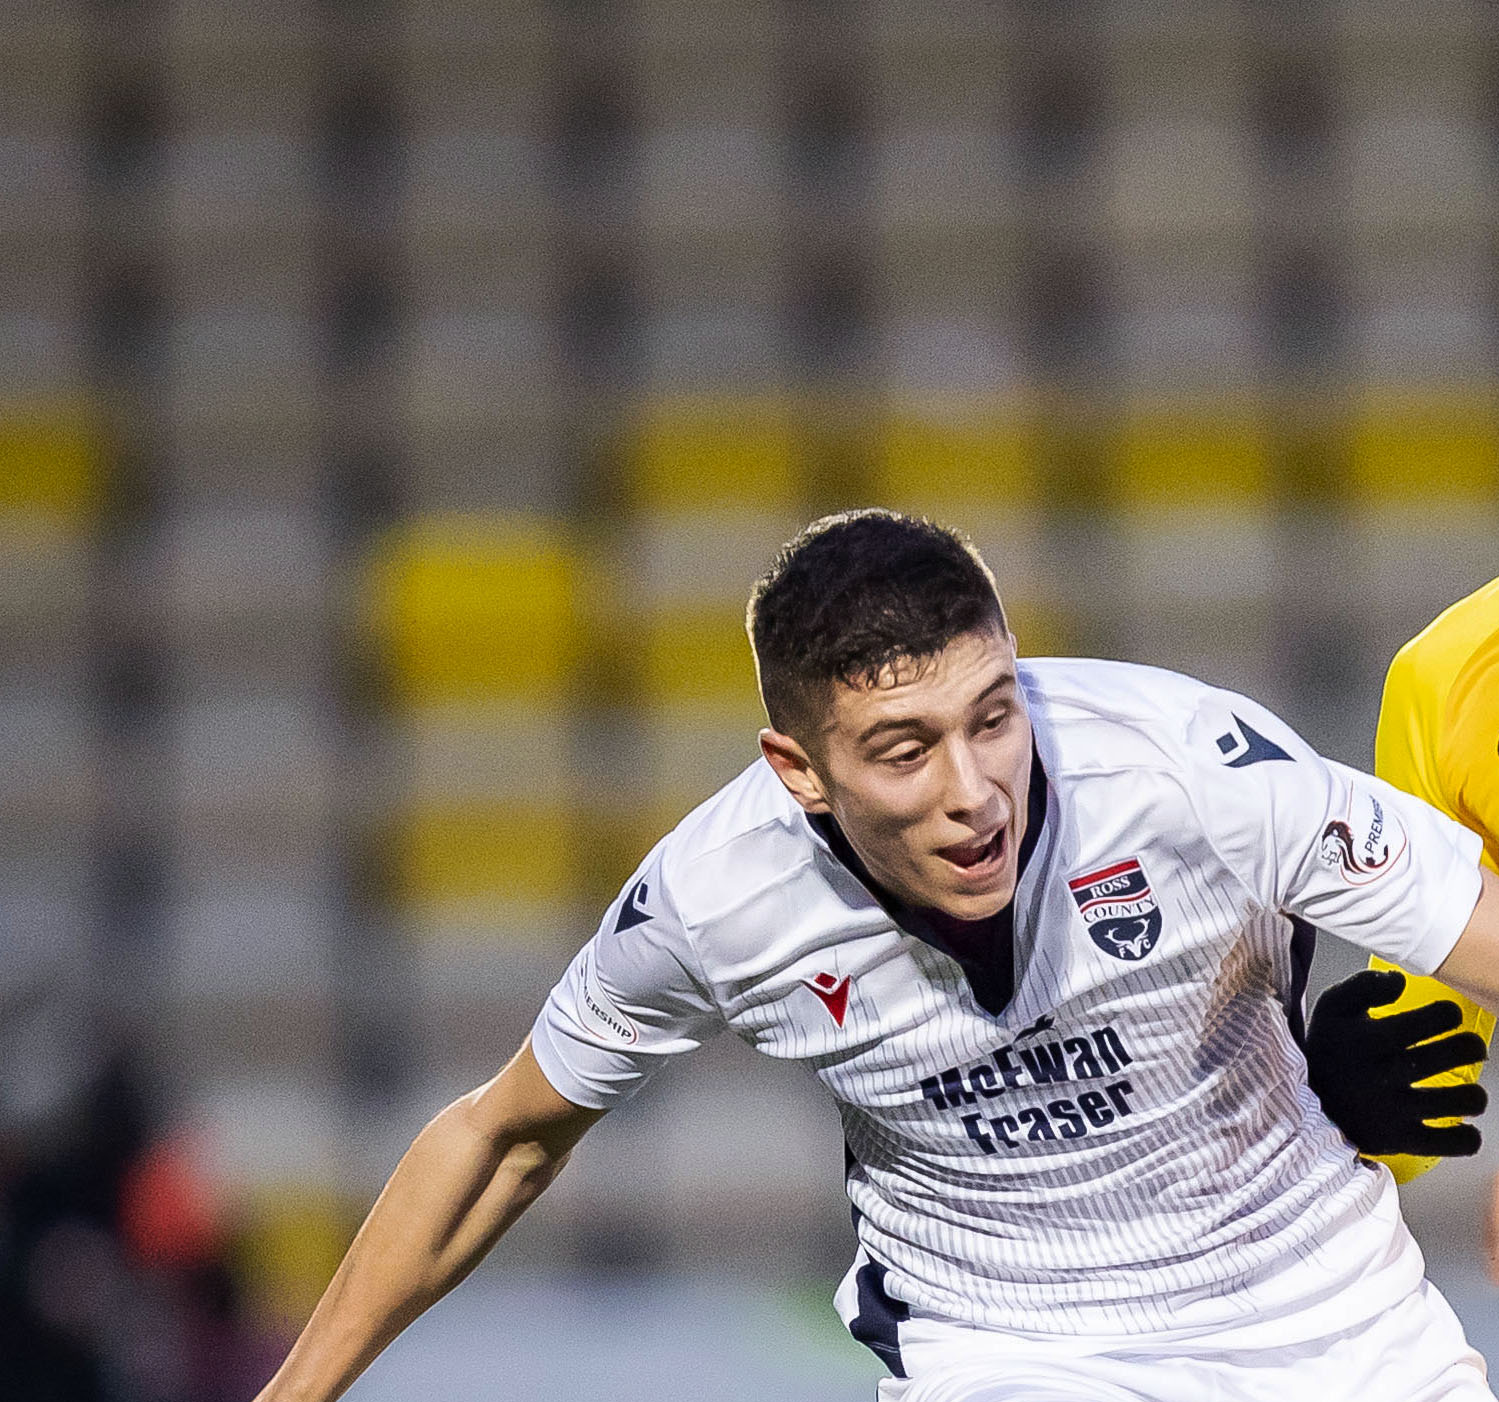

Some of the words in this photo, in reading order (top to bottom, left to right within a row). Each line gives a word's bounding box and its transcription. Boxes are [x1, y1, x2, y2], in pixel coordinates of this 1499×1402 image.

[1083, 896, 1156, 923] COUNTY
[1089, 875, 1131, 899] ROSS
[919, 1026, 1133, 1111] McEwan
[961, 1080, 1134, 1155] Fraser
